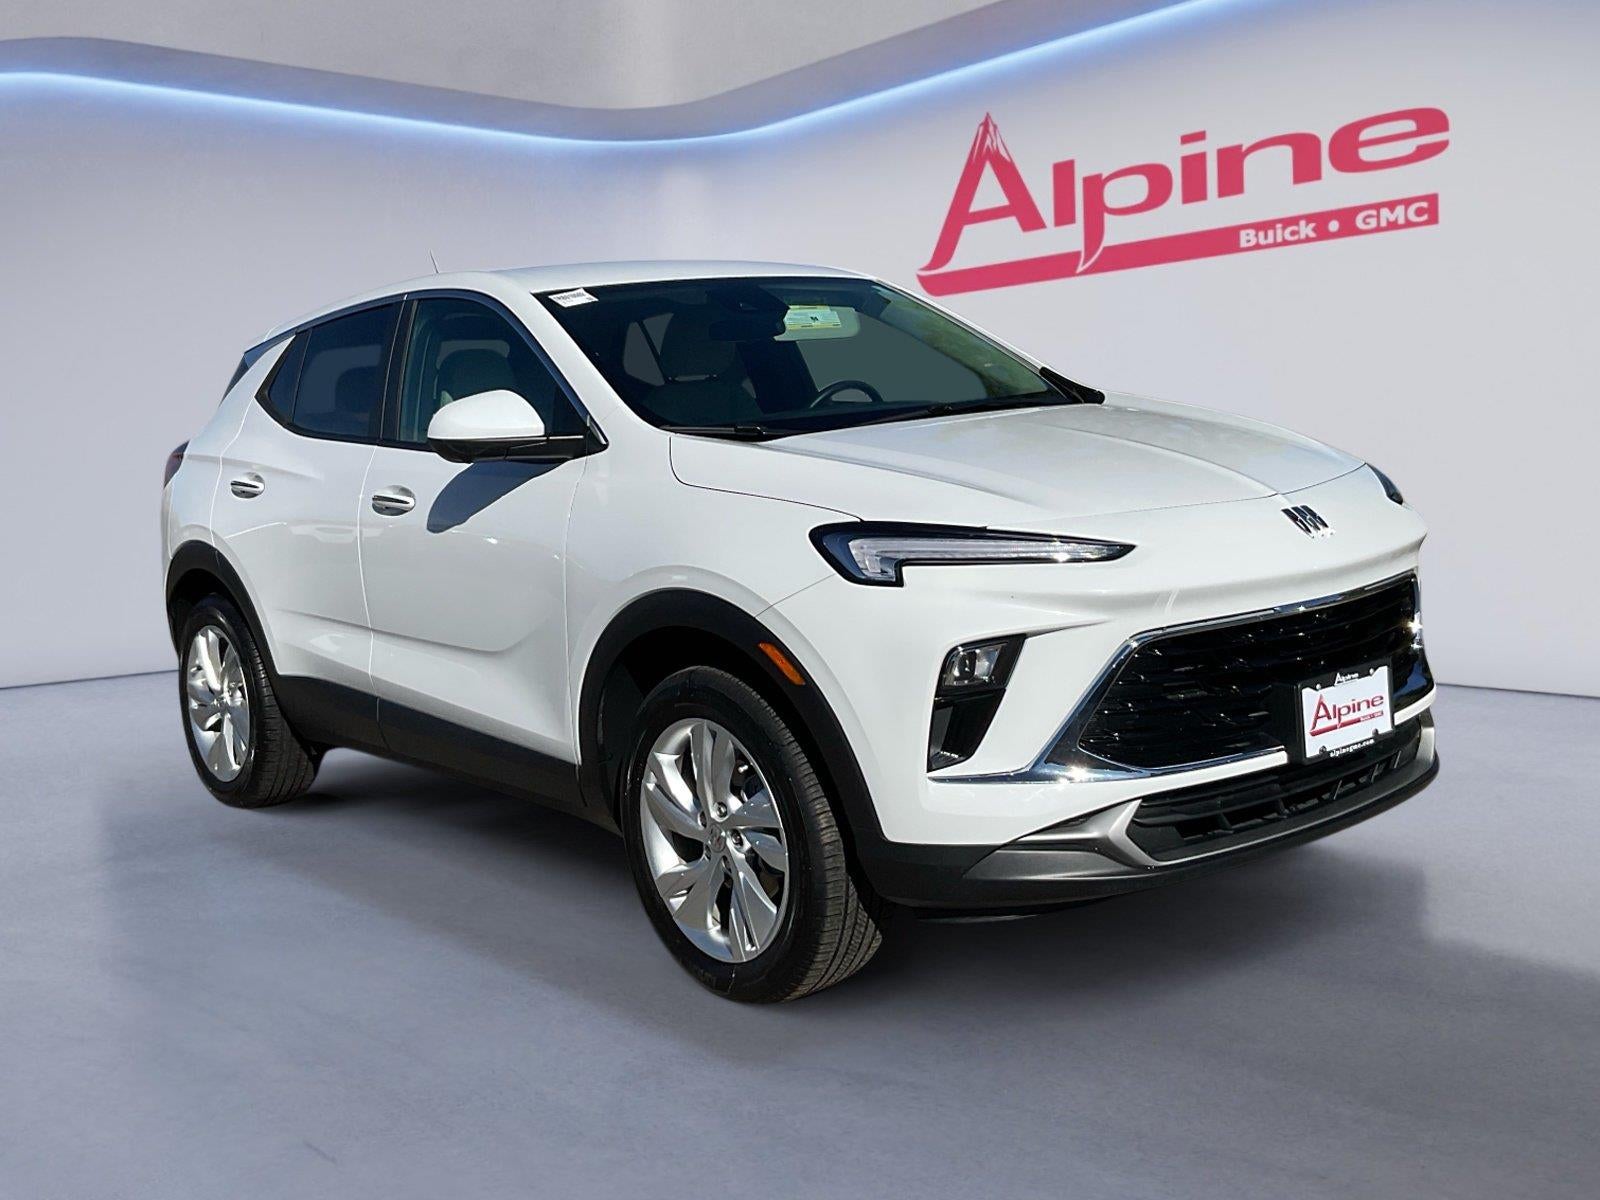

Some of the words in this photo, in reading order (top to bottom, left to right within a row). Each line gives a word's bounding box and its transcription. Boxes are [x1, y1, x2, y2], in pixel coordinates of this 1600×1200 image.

[917, 107, 1449, 273] Alpine
[1239, 220, 1317, 248] Buick
[1355, 202, 1429, 231] GMC
[1310, 694, 1384, 731] Alpine
